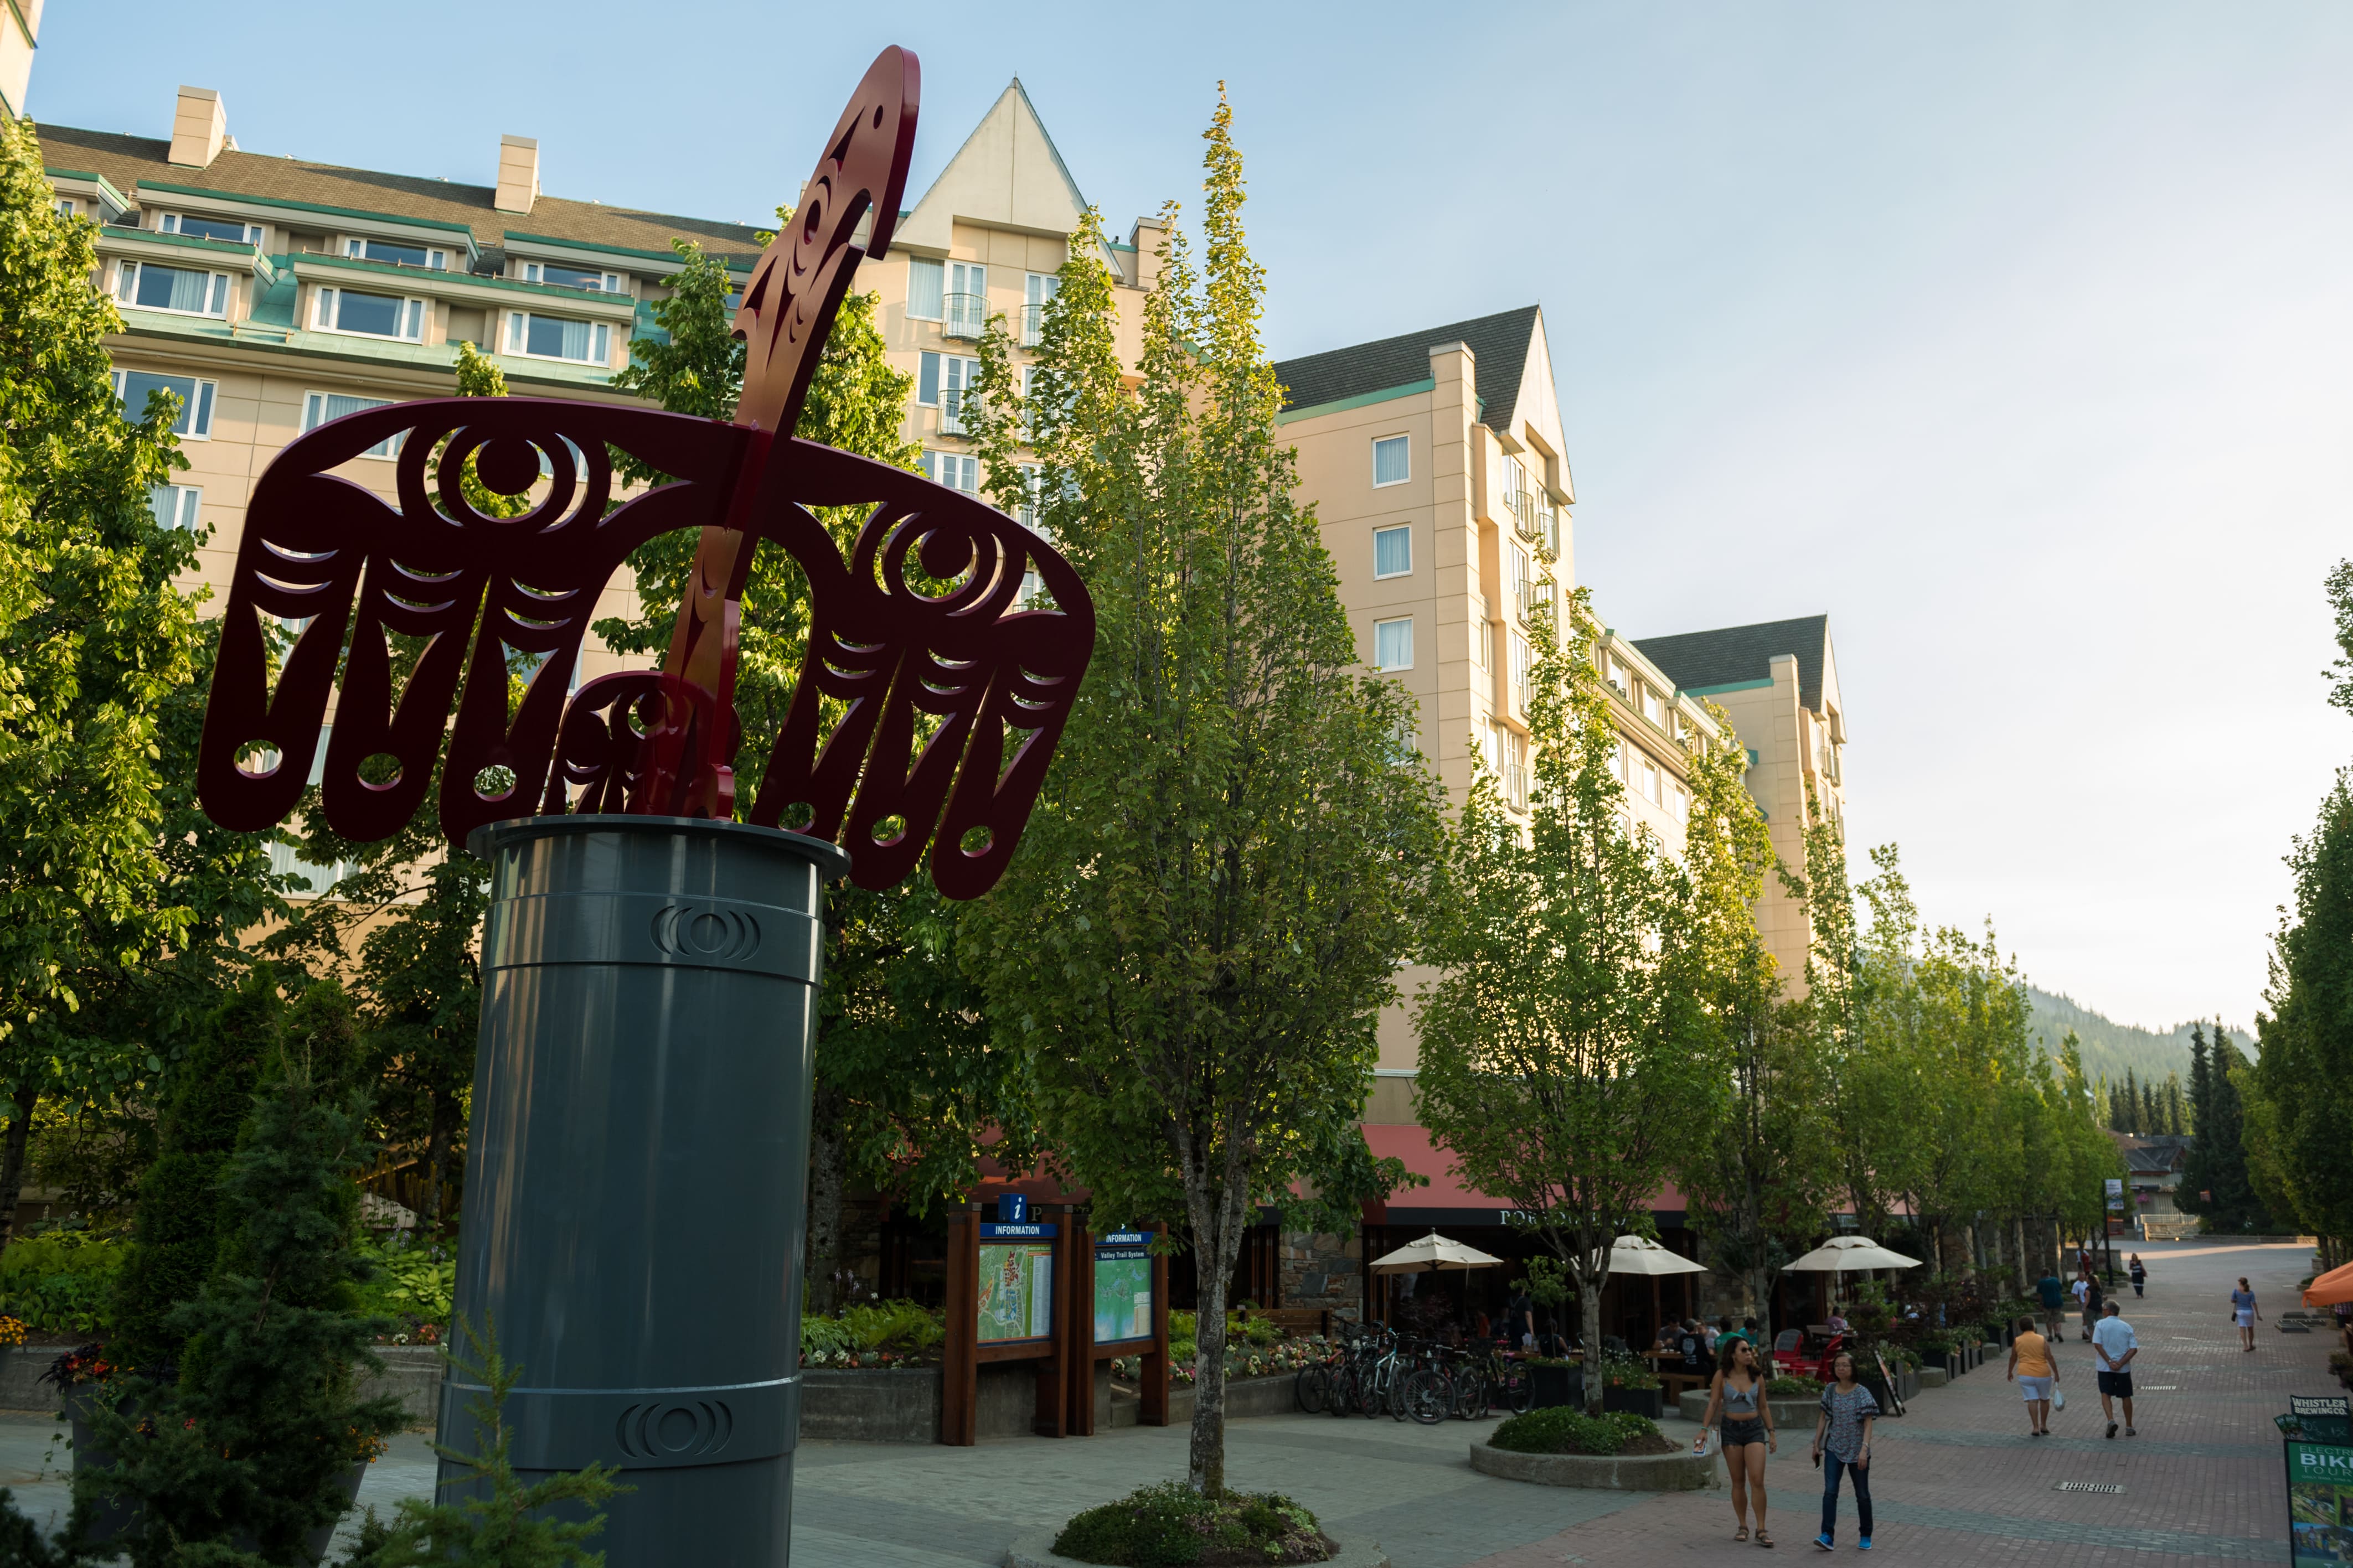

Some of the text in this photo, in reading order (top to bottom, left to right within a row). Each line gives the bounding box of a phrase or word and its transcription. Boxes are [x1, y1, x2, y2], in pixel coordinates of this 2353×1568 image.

[995, 1225, 1040, 1235] INFORMATION
[1106, 1234, 1142, 1243] INFORMATION
[2292, 1397, 2347, 1409] WHISTLER
